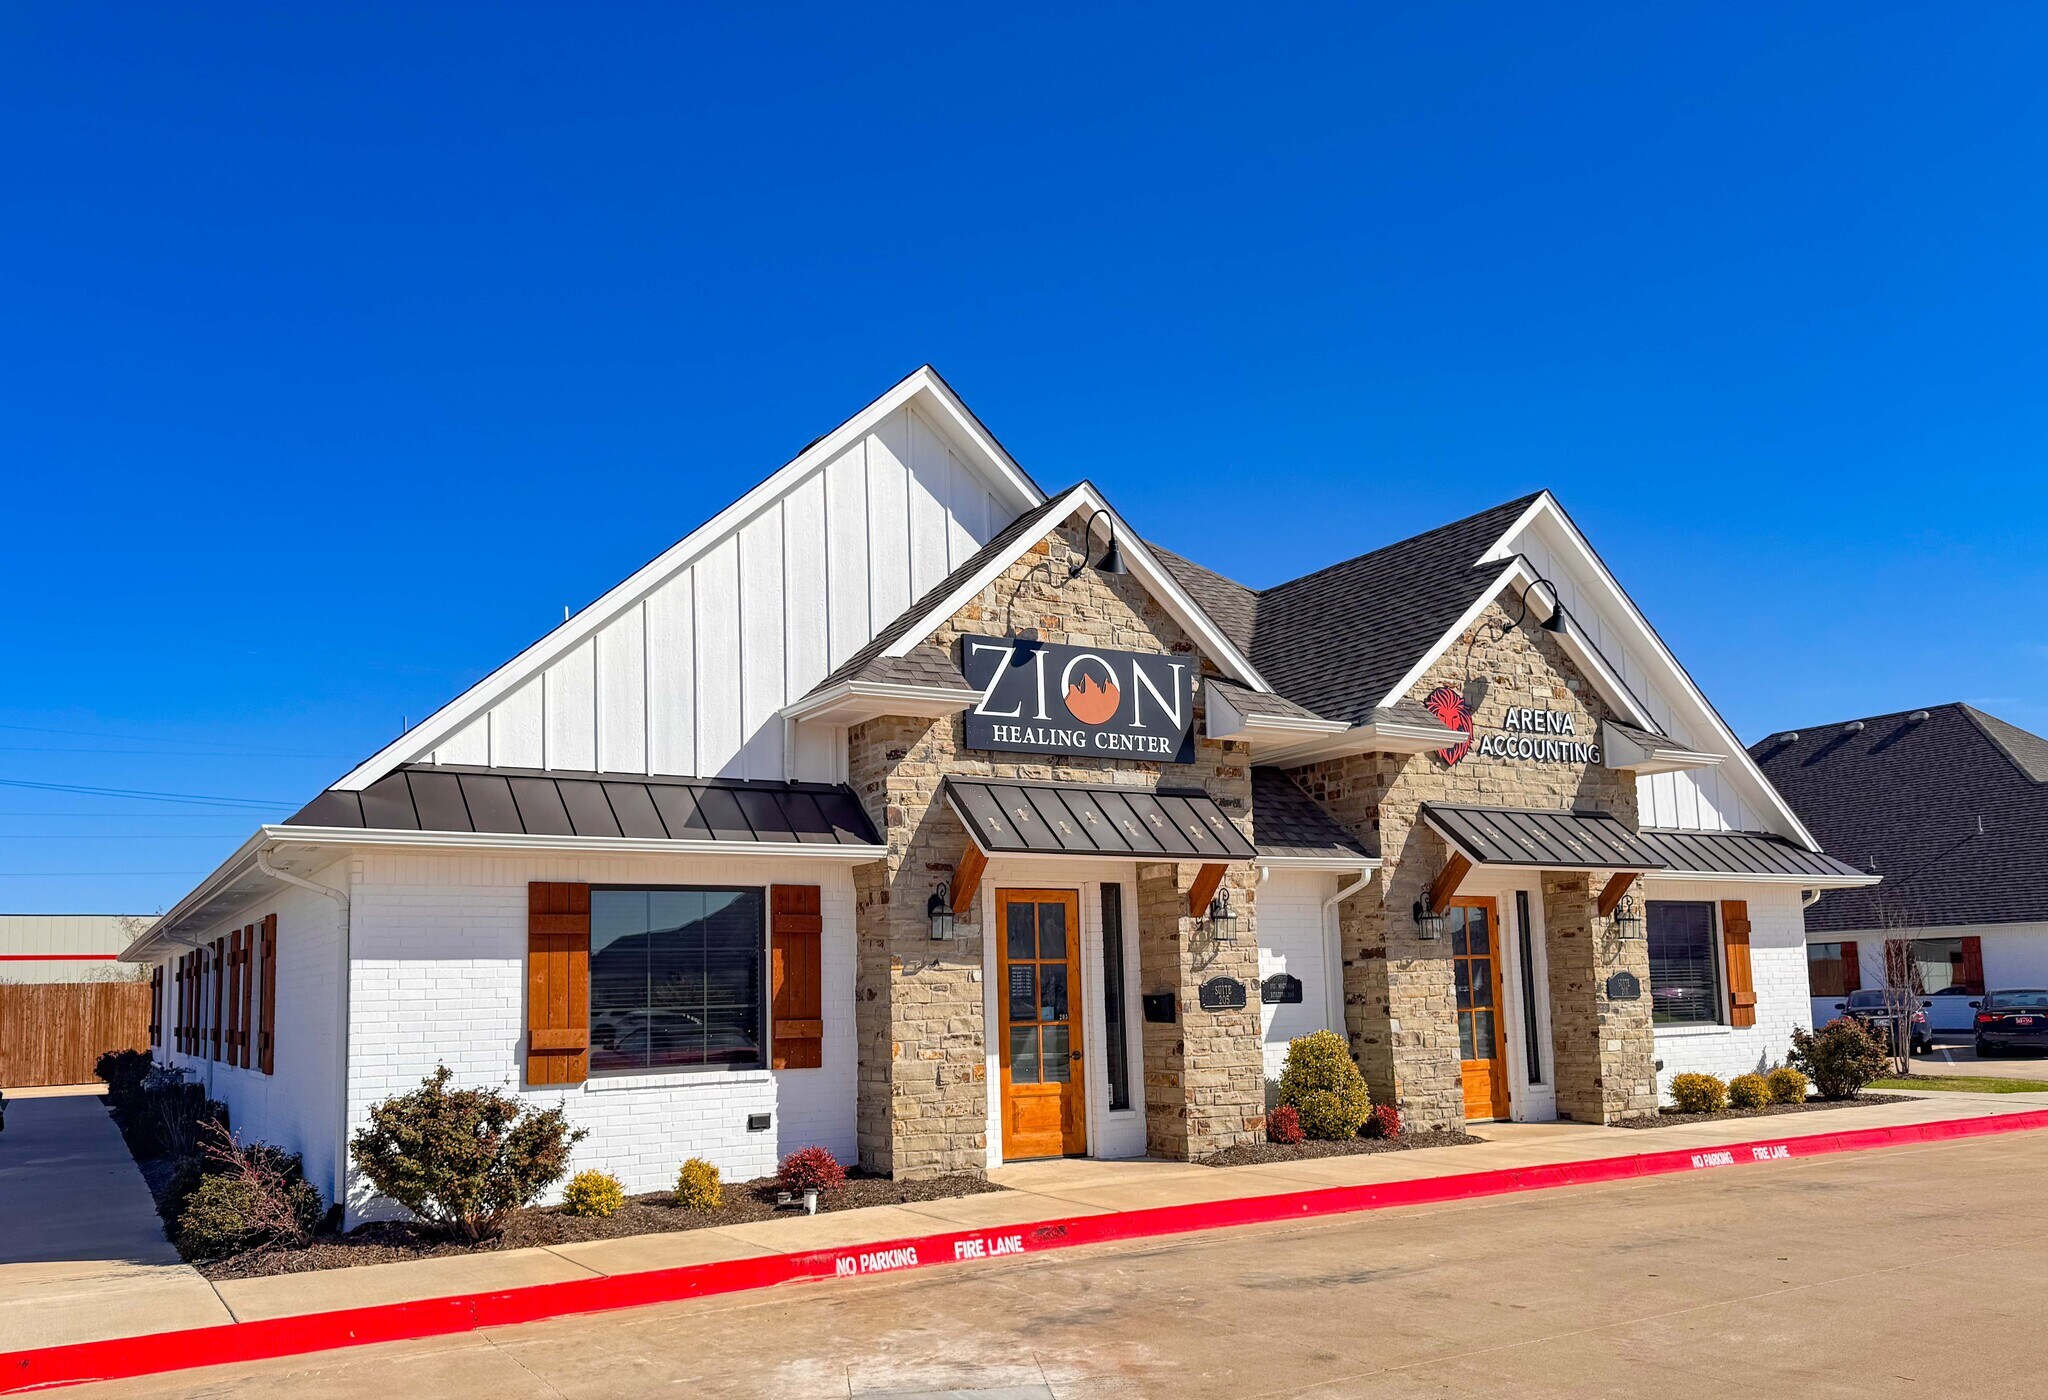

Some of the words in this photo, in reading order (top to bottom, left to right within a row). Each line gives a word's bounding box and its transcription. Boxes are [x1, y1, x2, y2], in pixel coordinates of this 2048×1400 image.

[971, 642, 1186, 731] ZION
[1505, 706, 1576, 735] ARENA
[992, 724, 1086, 748] HEALING
[1094, 732, 1172, 754] CENTER
[1480, 734, 1600, 764] ACCOUNTING
[1214, 985, 1232, 995] SUITE
[1218, 995, 1231, 1005] 205
[1691, 1154, 1704, 1168] NO
[1702, 1151, 1734, 1166] PARKING
[1752, 1146, 1770, 1160] FIRE
[1769, 1145, 1790, 1159] LANE
[835, 1257, 857, 1277] NO
[860, 1246, 918, 1272] PARKING
[954, 1238, 986, 1260] FIRE
[988, 1235, 1025, 1255] LANE
